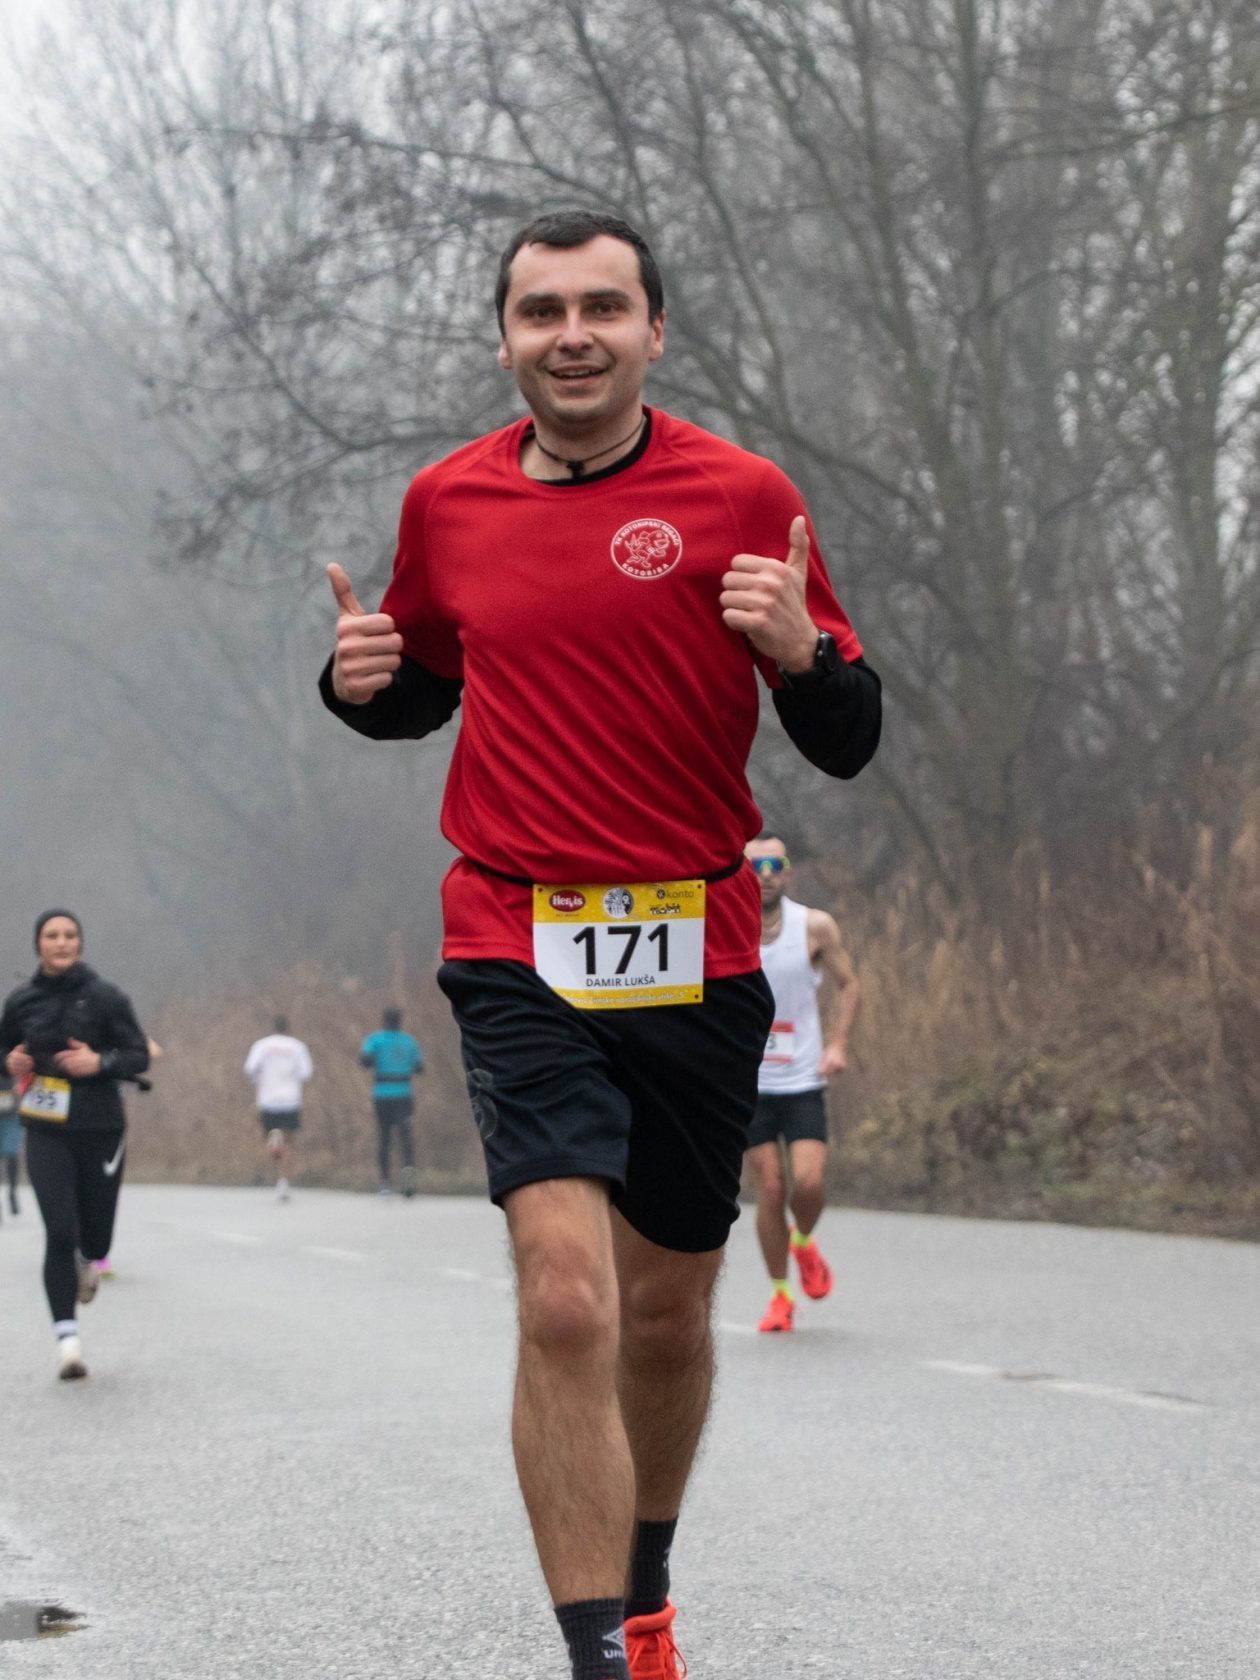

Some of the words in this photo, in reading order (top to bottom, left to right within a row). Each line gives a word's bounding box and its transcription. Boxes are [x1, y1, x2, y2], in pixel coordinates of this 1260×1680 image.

[572, 923, 668, 975] 171
[586, 978, 622, 987] DAMIR
[625, 975, 655, 987] LUKŠA
